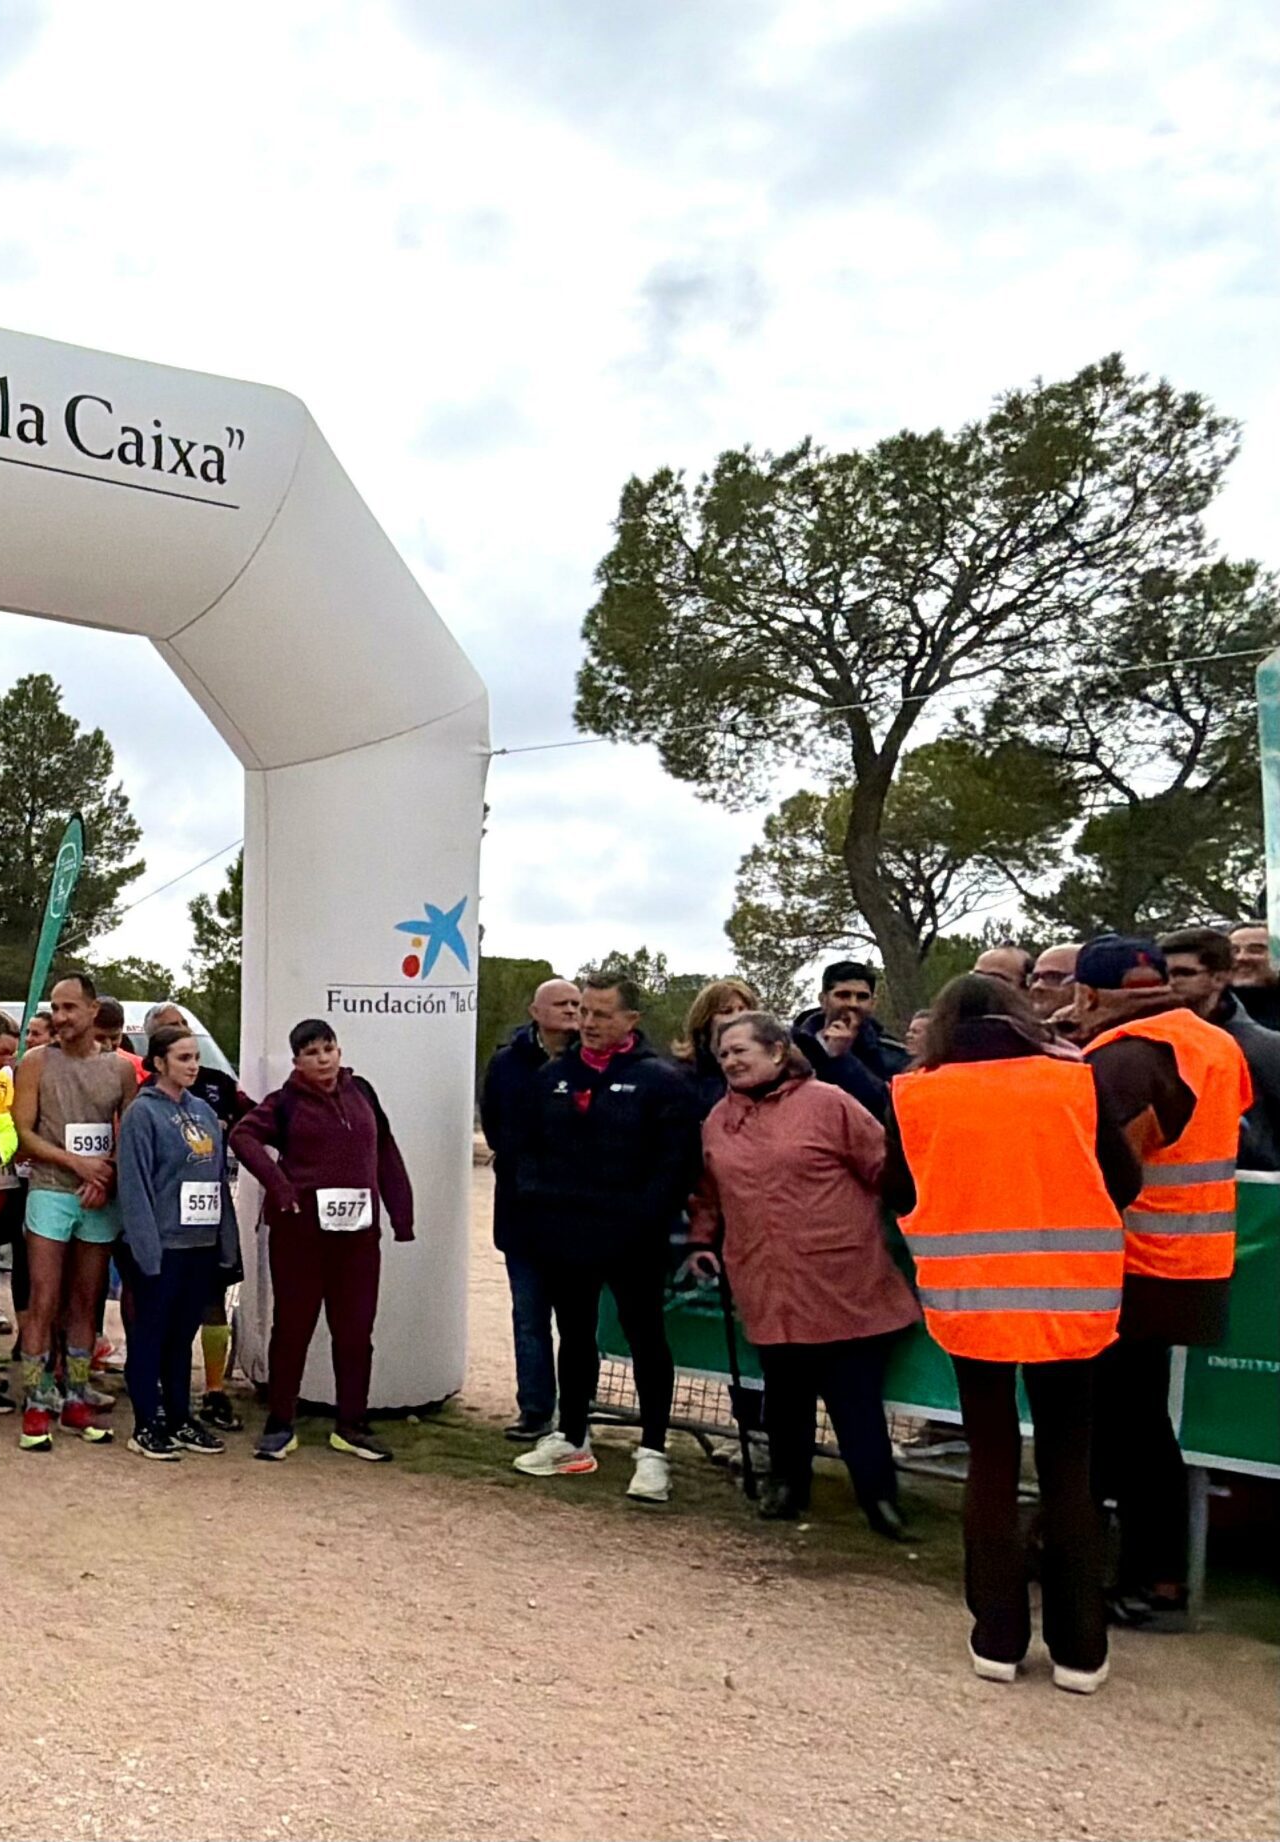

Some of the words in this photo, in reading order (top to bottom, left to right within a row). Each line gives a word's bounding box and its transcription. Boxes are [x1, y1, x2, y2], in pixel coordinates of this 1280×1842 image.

[64, 394, 245, 485] Caixa"
[327, 990, 446, 1014] Fundación
[73, 1135, 110, 1152] 5938
[326, 1200, 366, 1217] 5577
